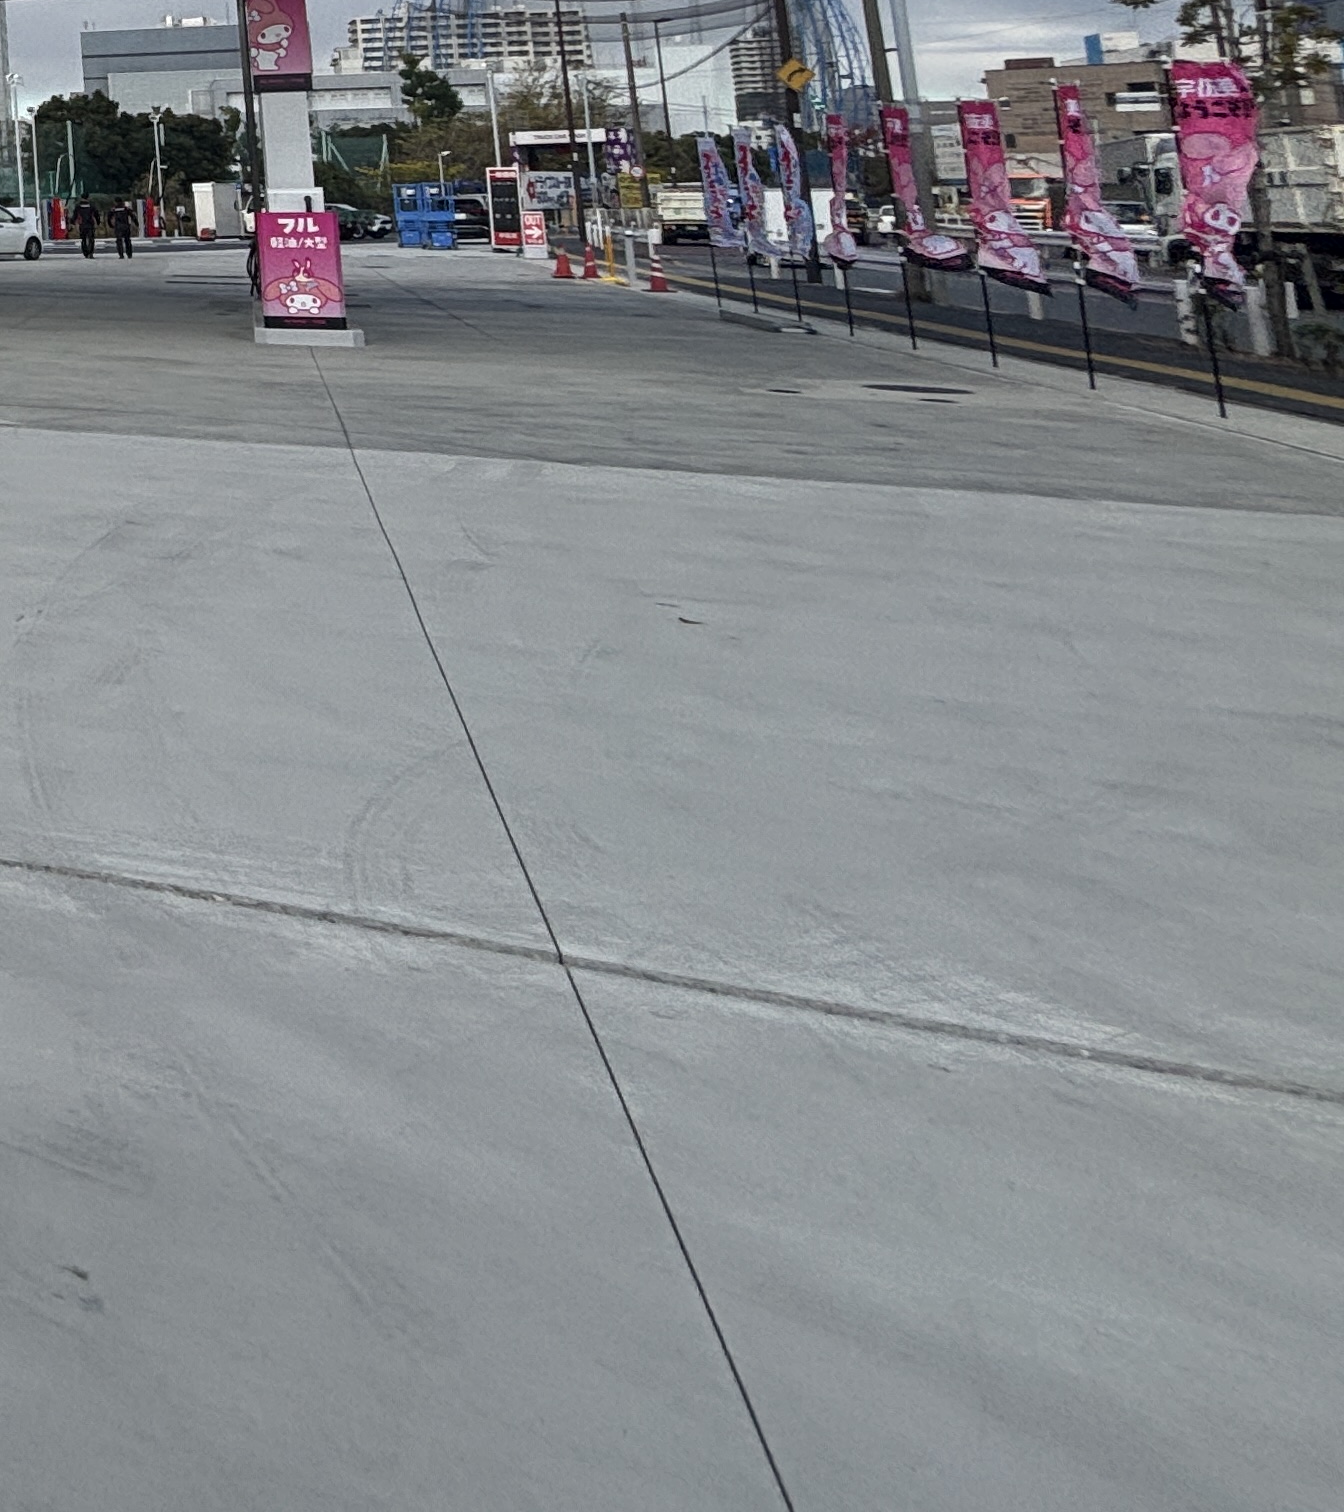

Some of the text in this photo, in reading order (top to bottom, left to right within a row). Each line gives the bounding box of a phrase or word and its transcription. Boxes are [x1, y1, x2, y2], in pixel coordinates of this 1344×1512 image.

[277, 217, 320, 234] フル
[524, 214, 542, 226] OUT
[270, 236, 328, 249] 軽油/大型
